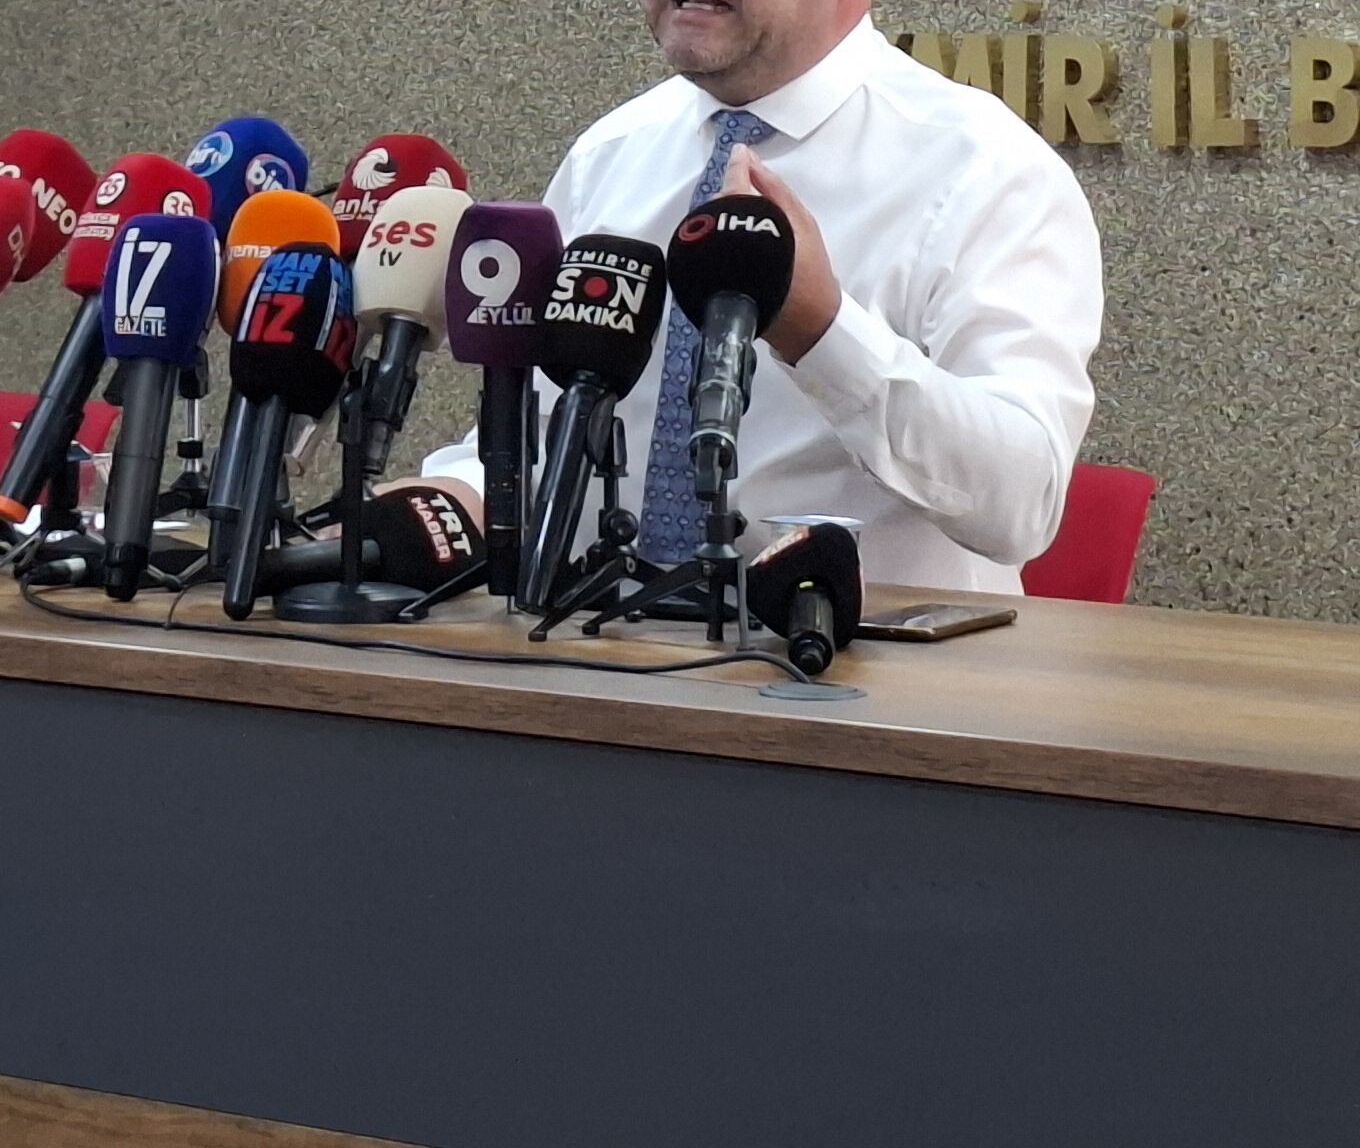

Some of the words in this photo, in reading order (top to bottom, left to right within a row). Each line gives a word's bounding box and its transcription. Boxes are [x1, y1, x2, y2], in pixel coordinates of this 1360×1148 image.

[1151, 4, 1259, 149] İL
[31, 177, 77, 235] NEO
[170, 195, 193, 216] 35
[333, 191, 385, 214] ank
[367, 220, 437, 248] ses
[379, 248, 402, 266] tv
[460, 238, 521, 307] 9
[429, 493, 472, 556] TRT
